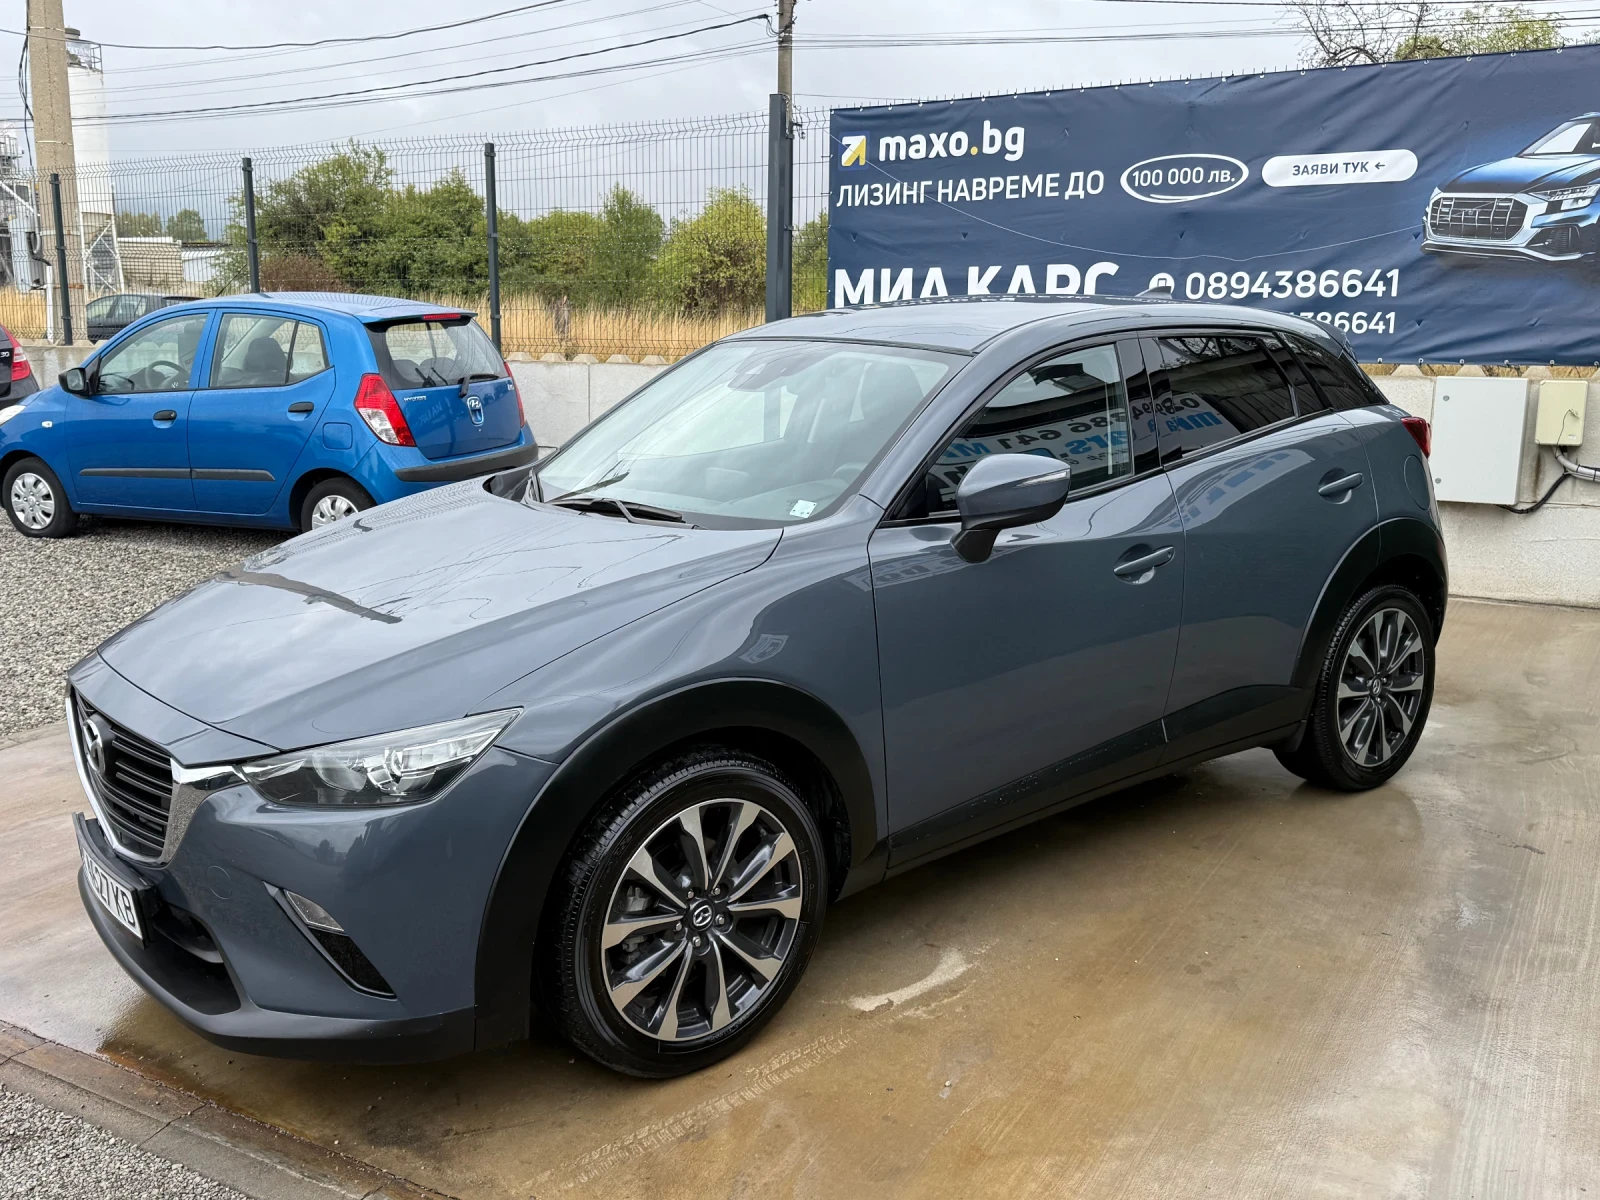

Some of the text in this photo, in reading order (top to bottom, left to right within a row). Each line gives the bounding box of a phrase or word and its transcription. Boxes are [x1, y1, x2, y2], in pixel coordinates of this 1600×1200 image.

[878, 119, 1025, 162] maxo.bg
[836, 180, 933, 207] ЛИЗИНГ
[937, 173, 1060, 202] НАВРЕМЕ
[1064, 170, 1105, 201] ДО
[1132, 168, 1162, 187] 100
[1167, 166, 1204, 185] 000
[1292, 161, 1369, 176] ЗАЯВИ ТУК
[1185, 268, 1400, 299] 0894386641
